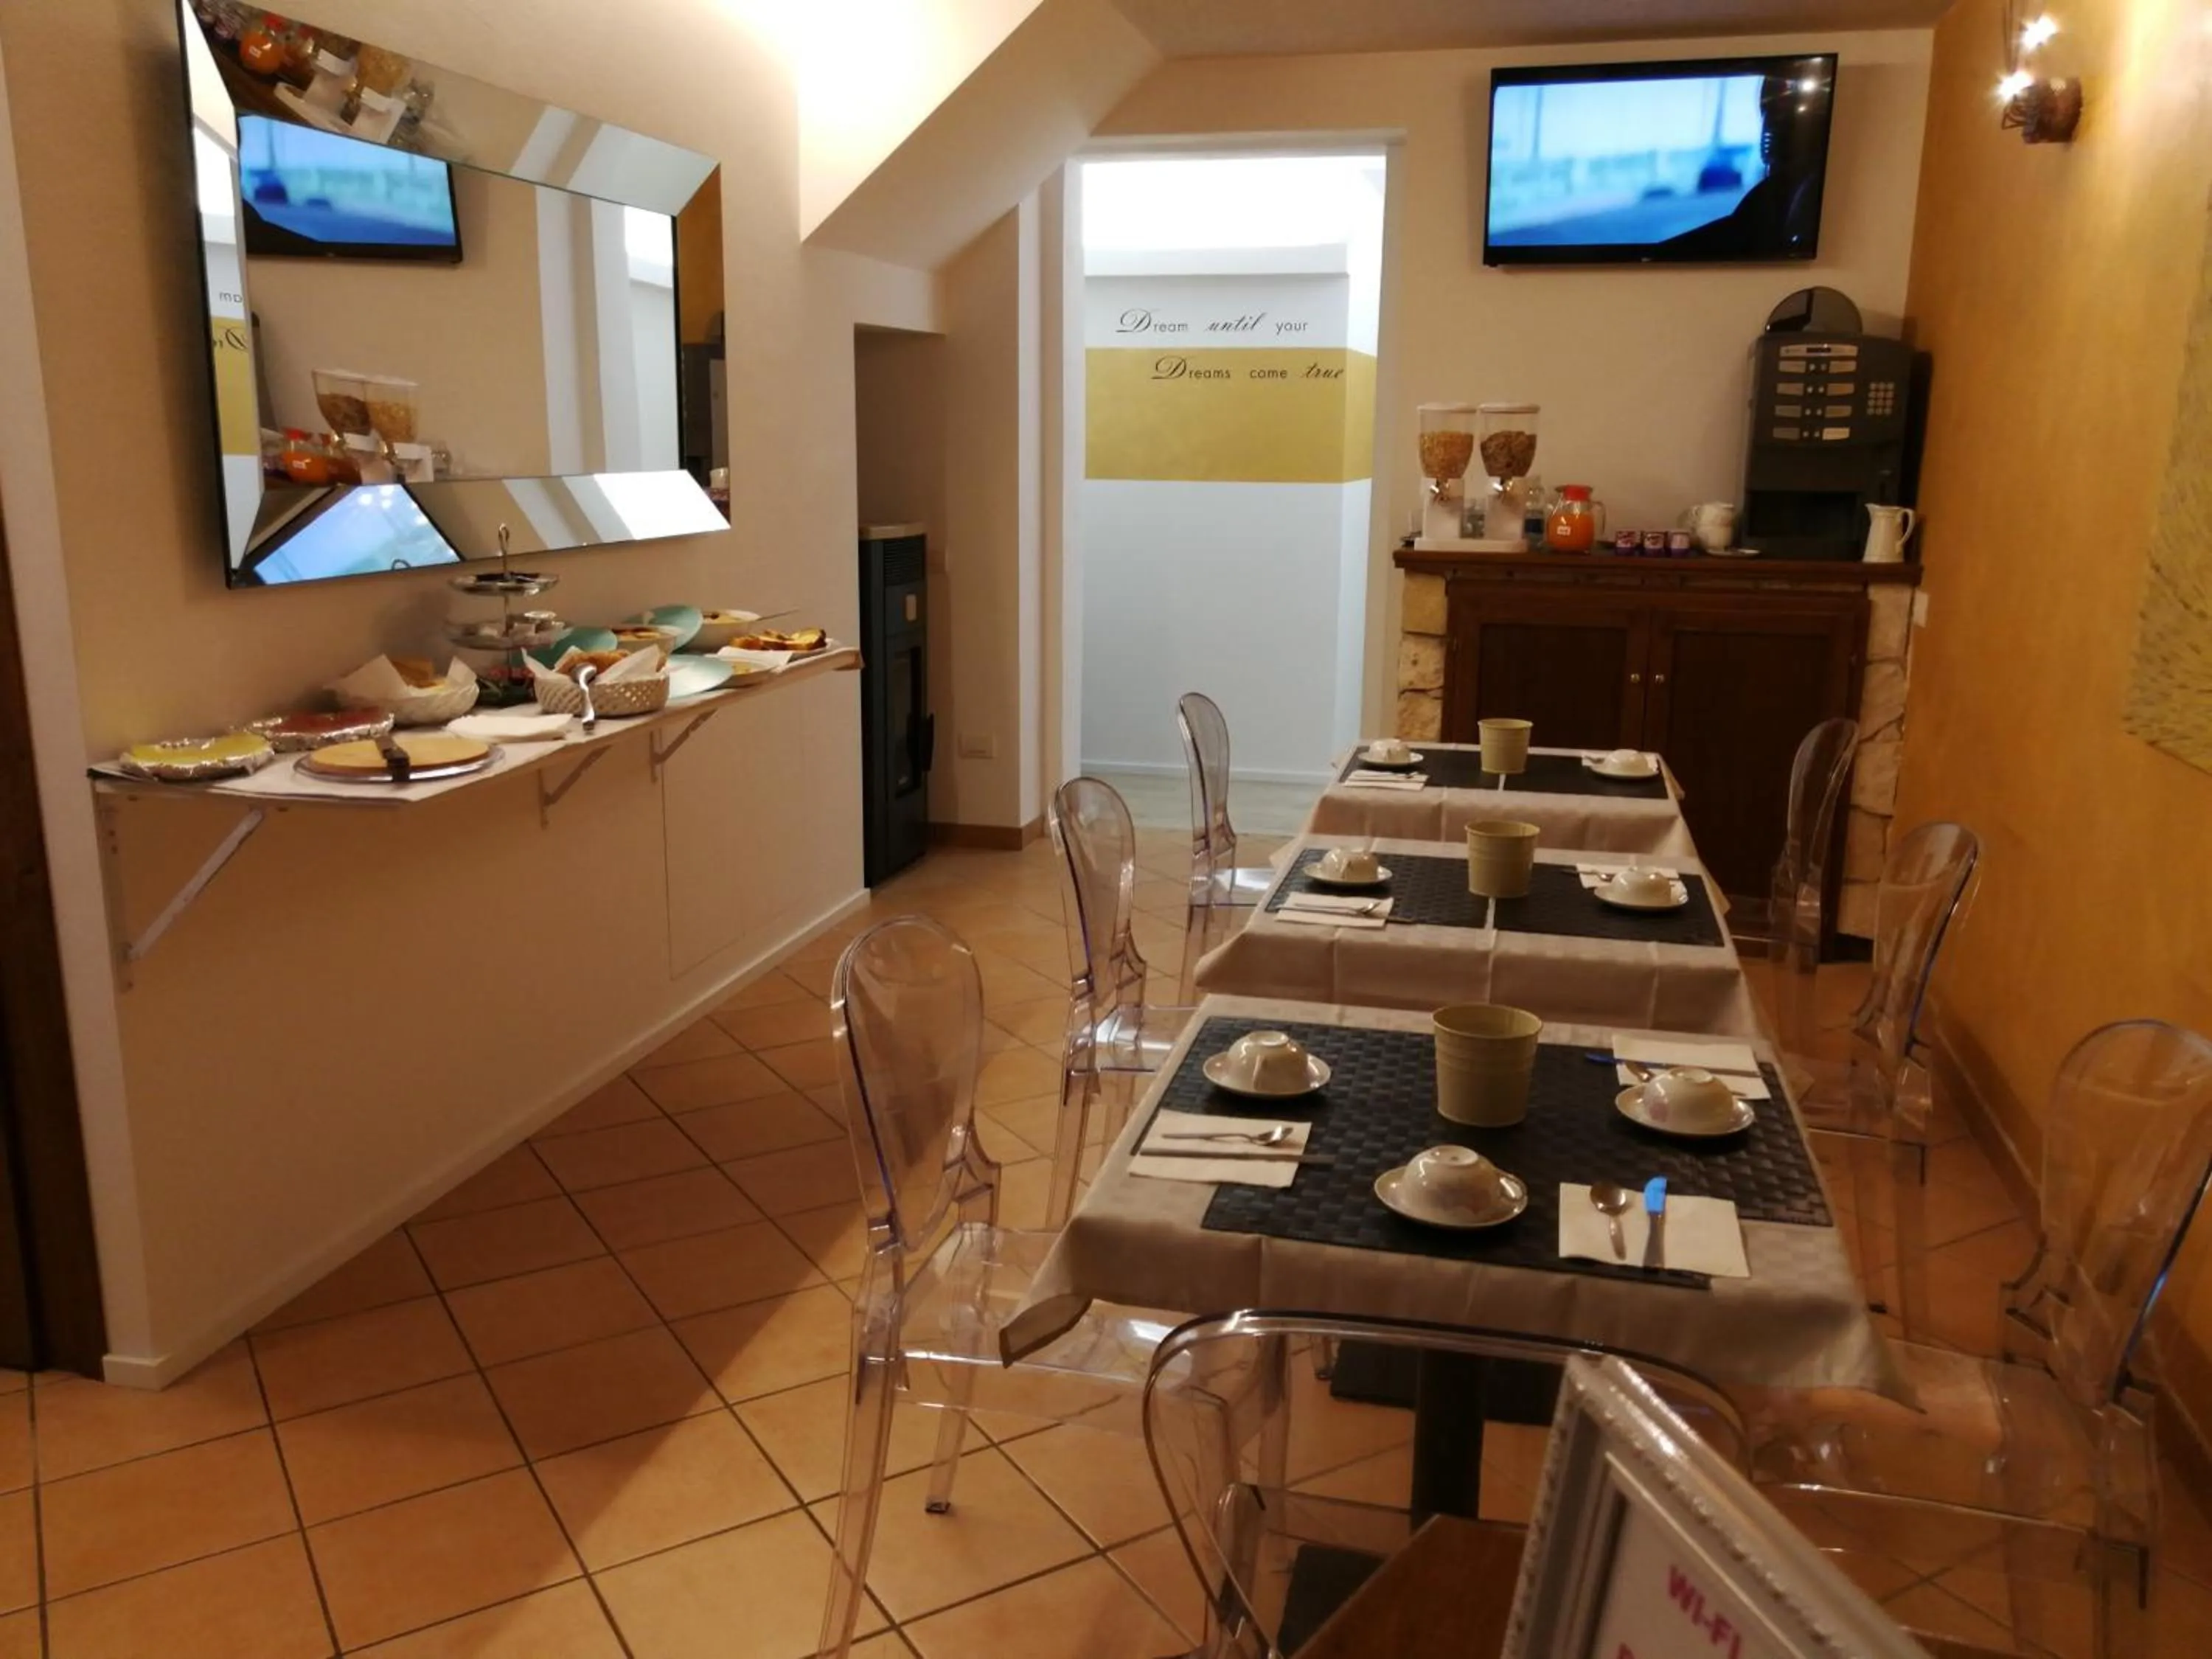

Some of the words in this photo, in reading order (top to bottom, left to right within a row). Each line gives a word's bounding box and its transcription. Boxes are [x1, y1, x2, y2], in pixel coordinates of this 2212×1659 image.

[1116, 307, 1189, 333] Dream
[1205, 312, 1267, 331] until
[1276, 321, 1309, 335] your
[1151, 355, 1231, 380] Dreams
[1249, 369, 1288, 379] come
[1300, 362, 1344, 379] true
